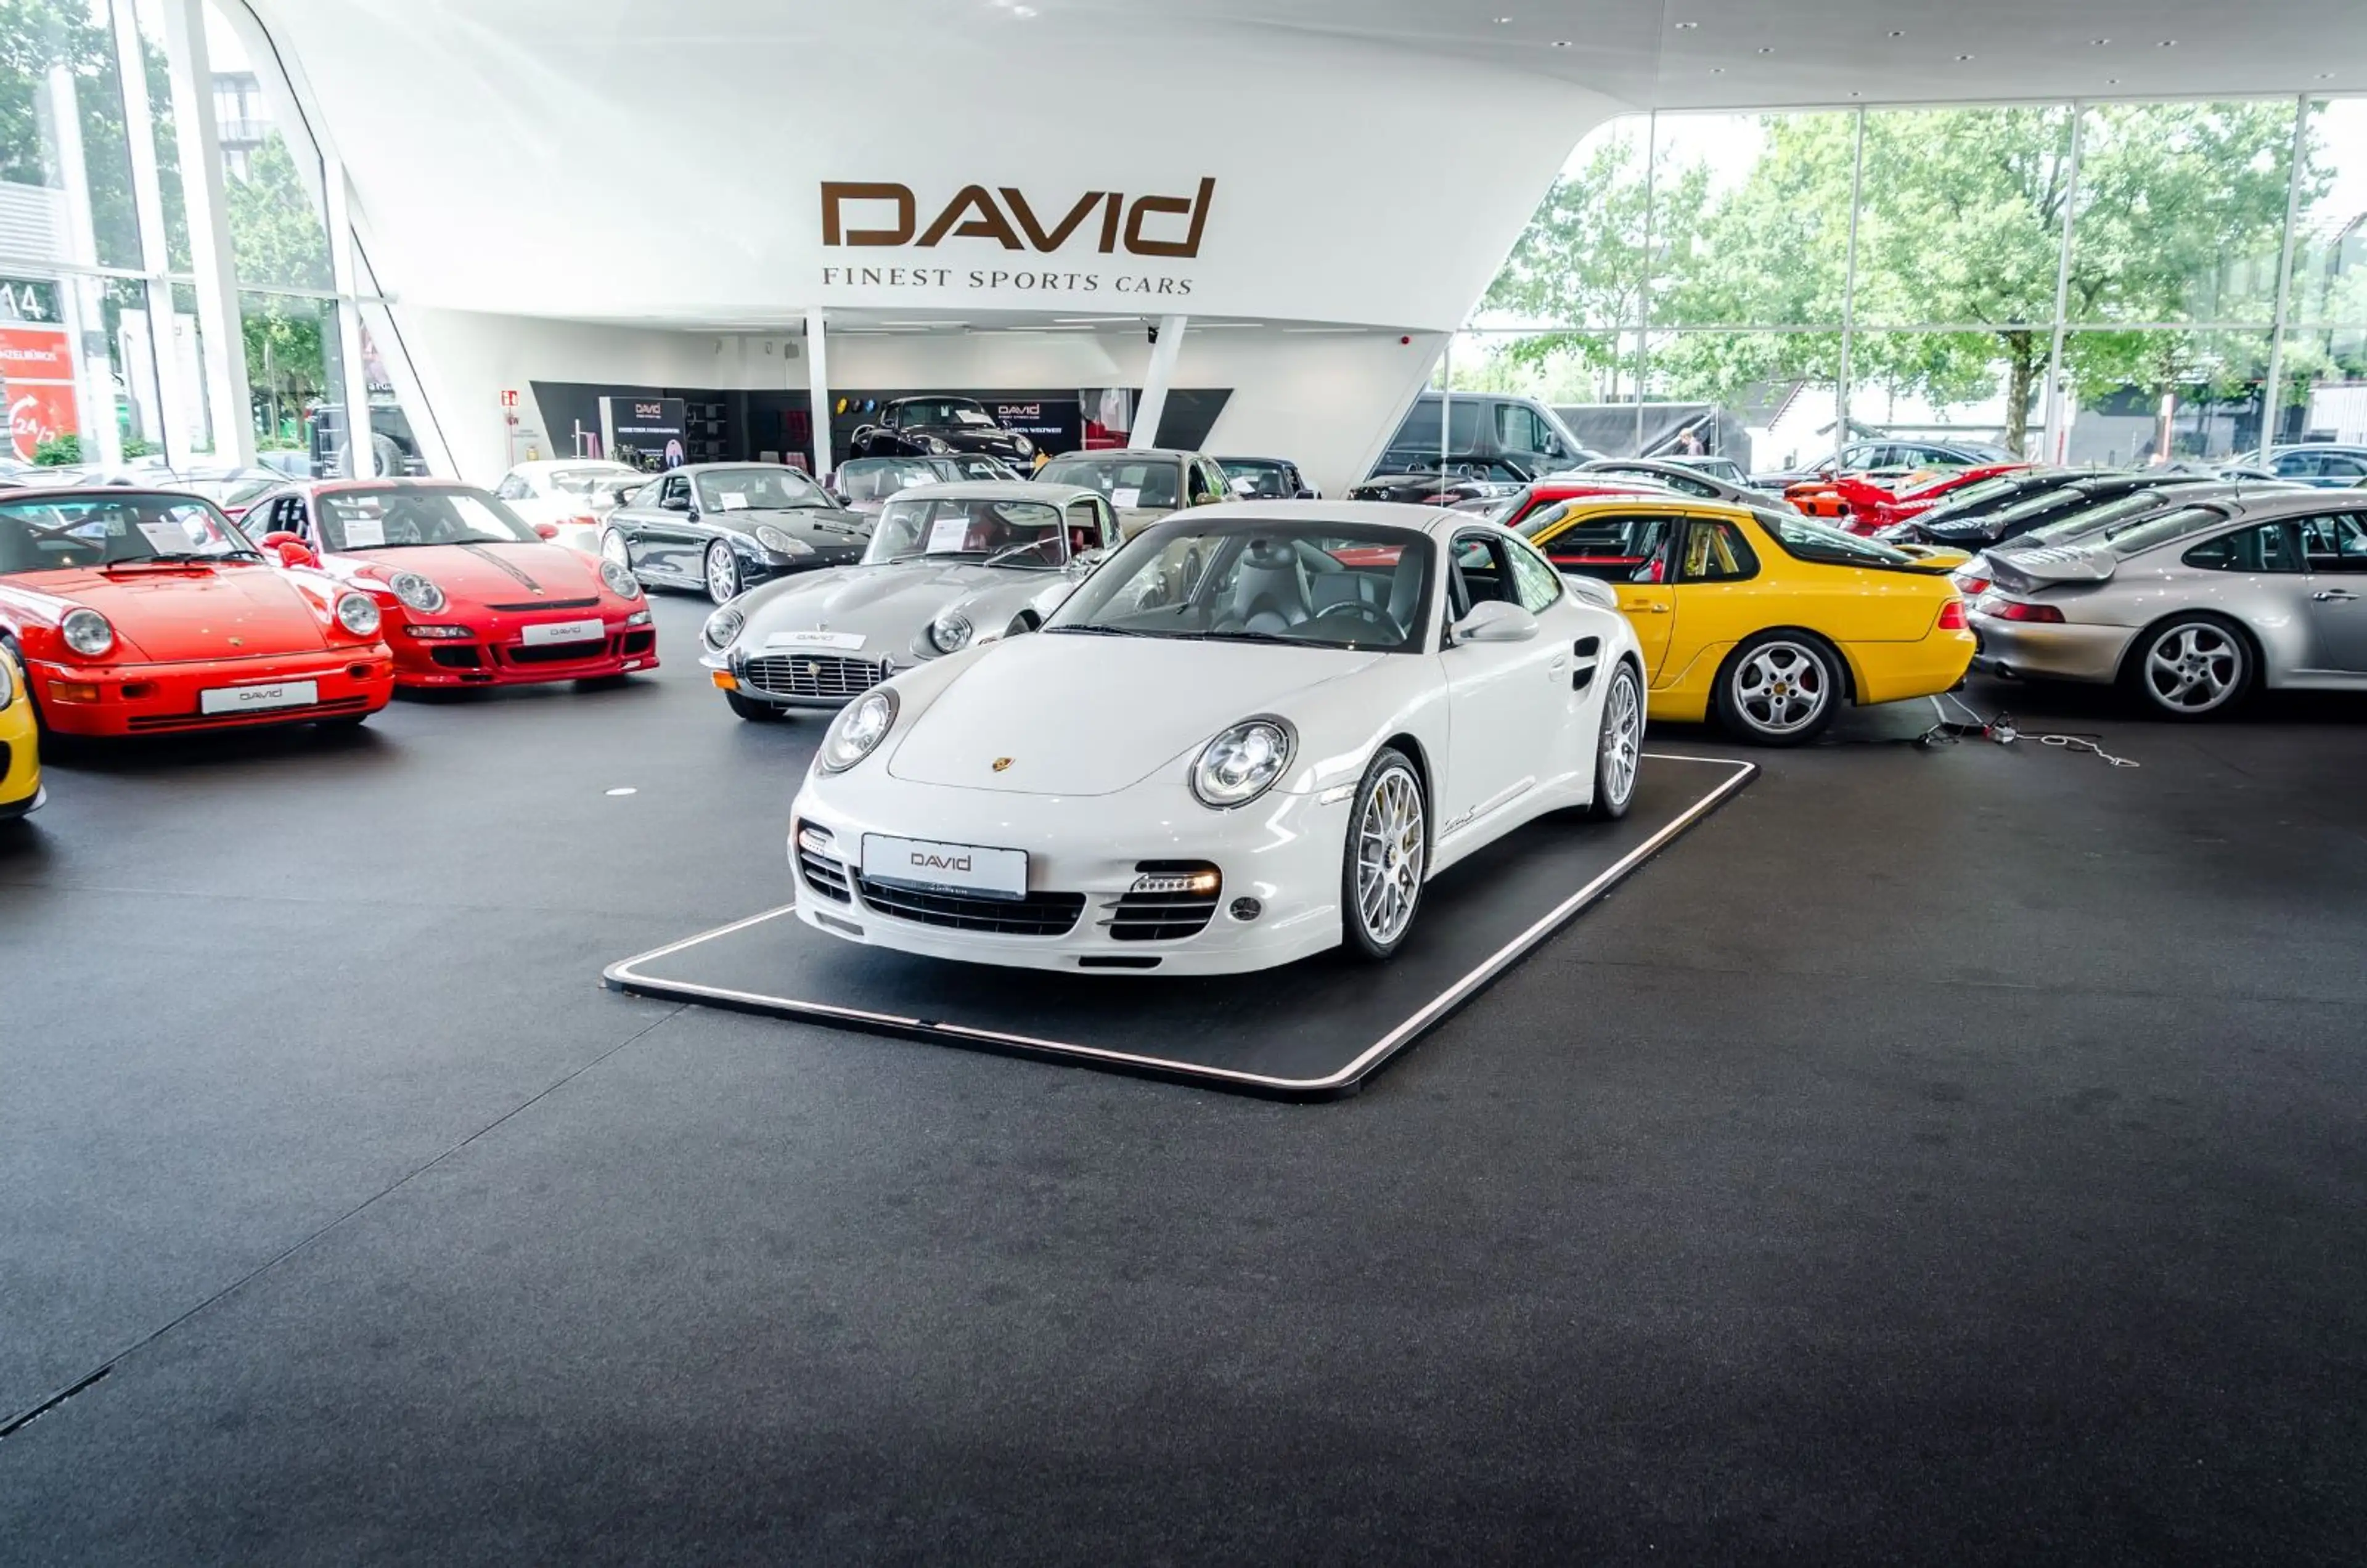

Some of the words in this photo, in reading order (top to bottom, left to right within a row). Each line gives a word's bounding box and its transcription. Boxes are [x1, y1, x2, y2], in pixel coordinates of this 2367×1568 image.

[823, 267, 952, 287] FINEST
[968, 270, 1098, 291] SPORTS
[1115, 276, 1193, 295] CARS
